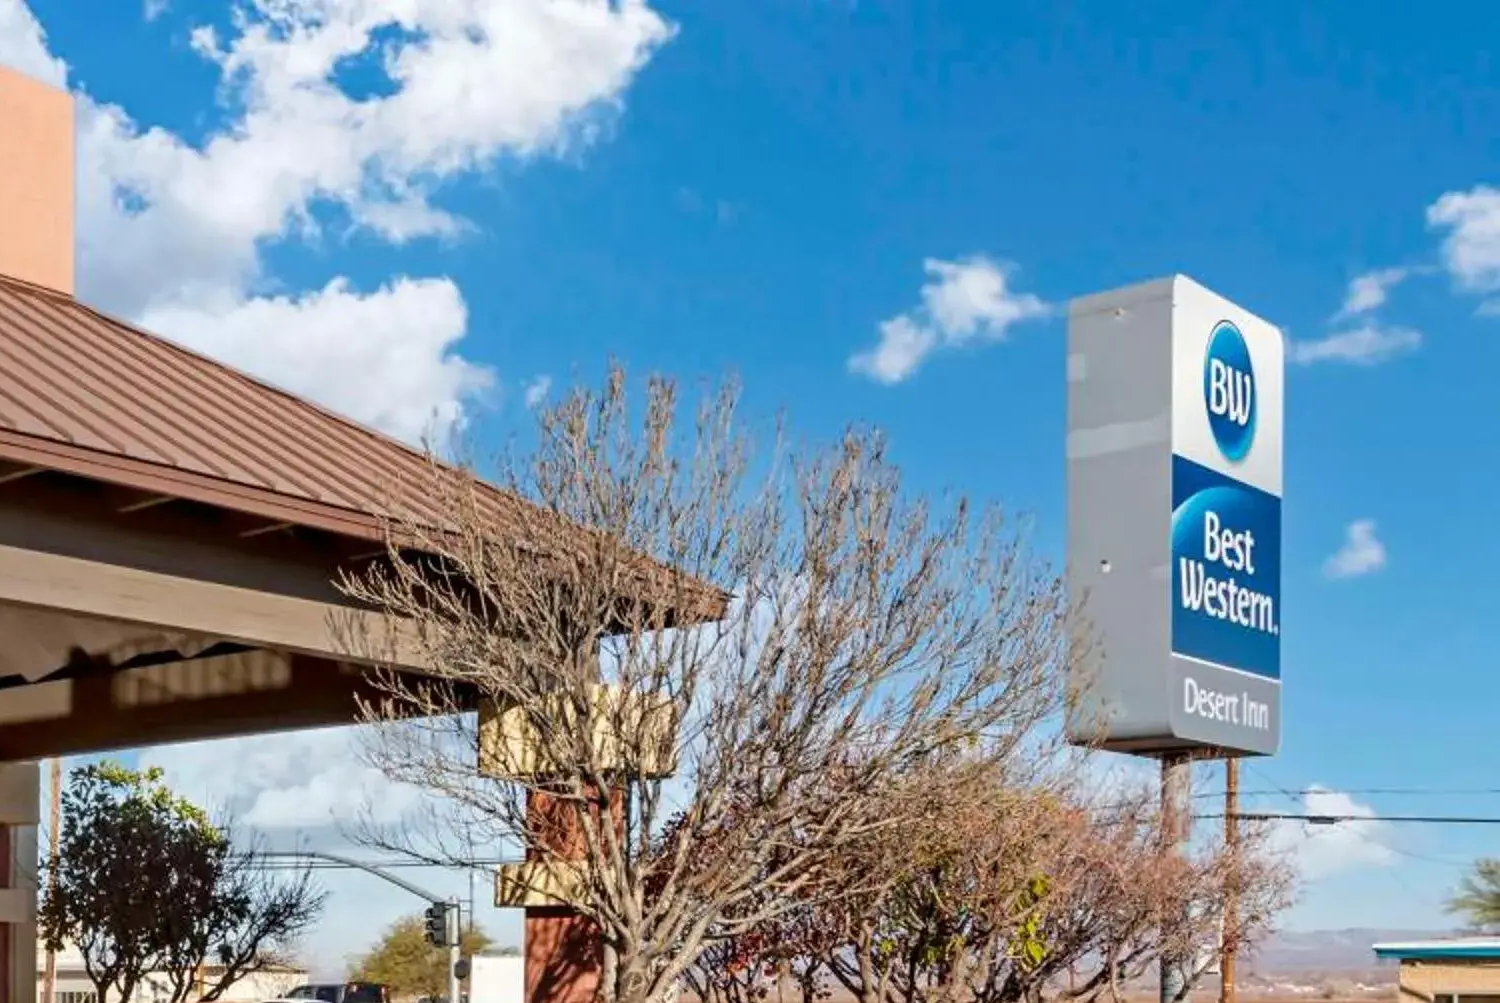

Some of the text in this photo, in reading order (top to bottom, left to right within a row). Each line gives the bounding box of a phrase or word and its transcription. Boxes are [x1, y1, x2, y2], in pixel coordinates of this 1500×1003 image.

[1210, 358, 1251, 427] BW
[1204, 510, 1255, 575] Best
[1184, 677, 1269, 730] Desert Inn
